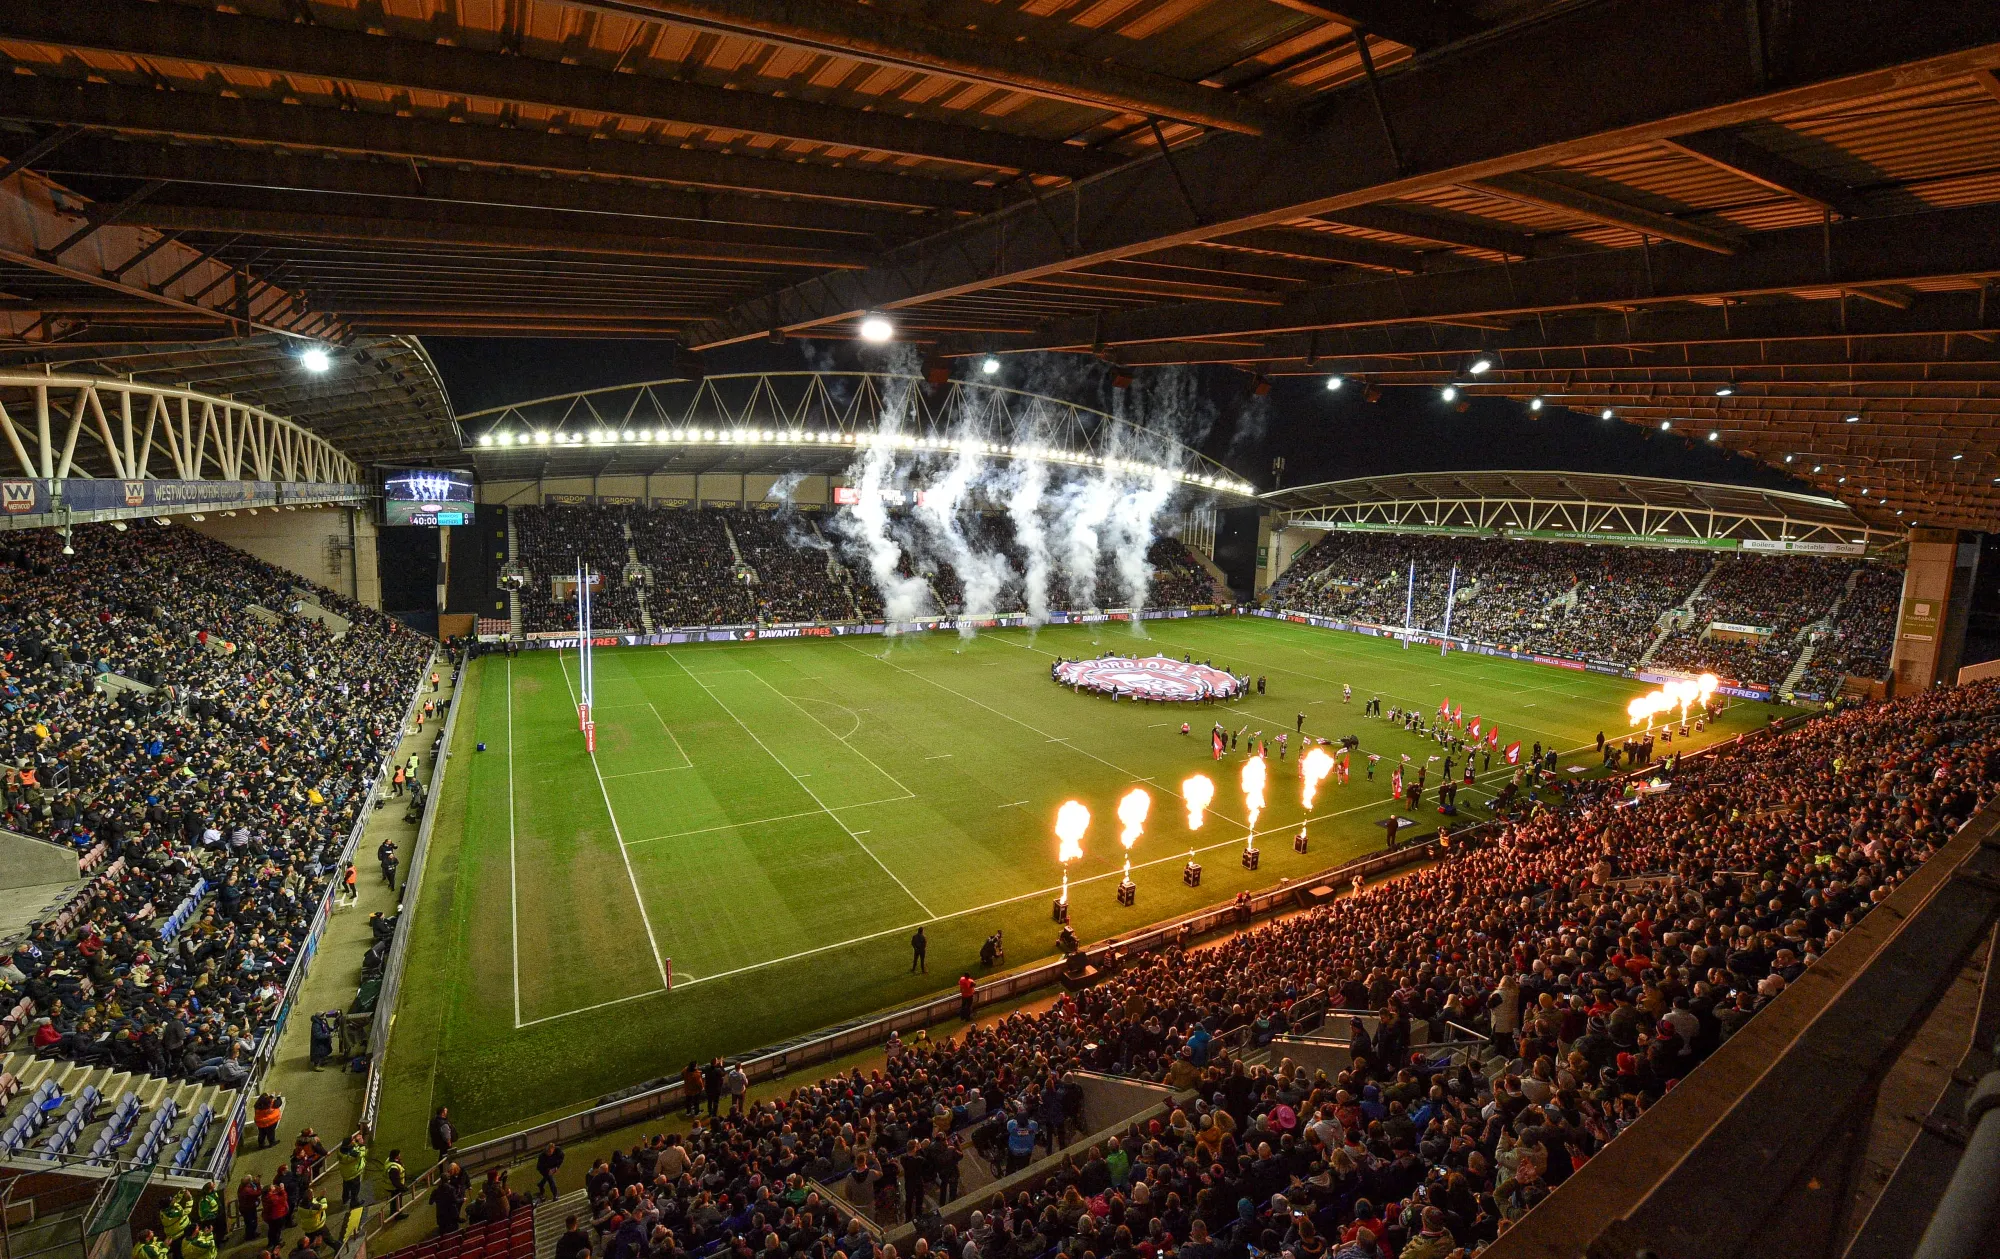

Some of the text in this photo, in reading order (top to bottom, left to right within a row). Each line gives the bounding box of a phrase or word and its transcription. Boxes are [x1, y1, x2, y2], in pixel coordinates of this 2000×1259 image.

[154, 484, 196, 501] WESTWOOD
[8, 503, 30, 511] WESTWOOD
[413, 517, 437, 525] 40:00
